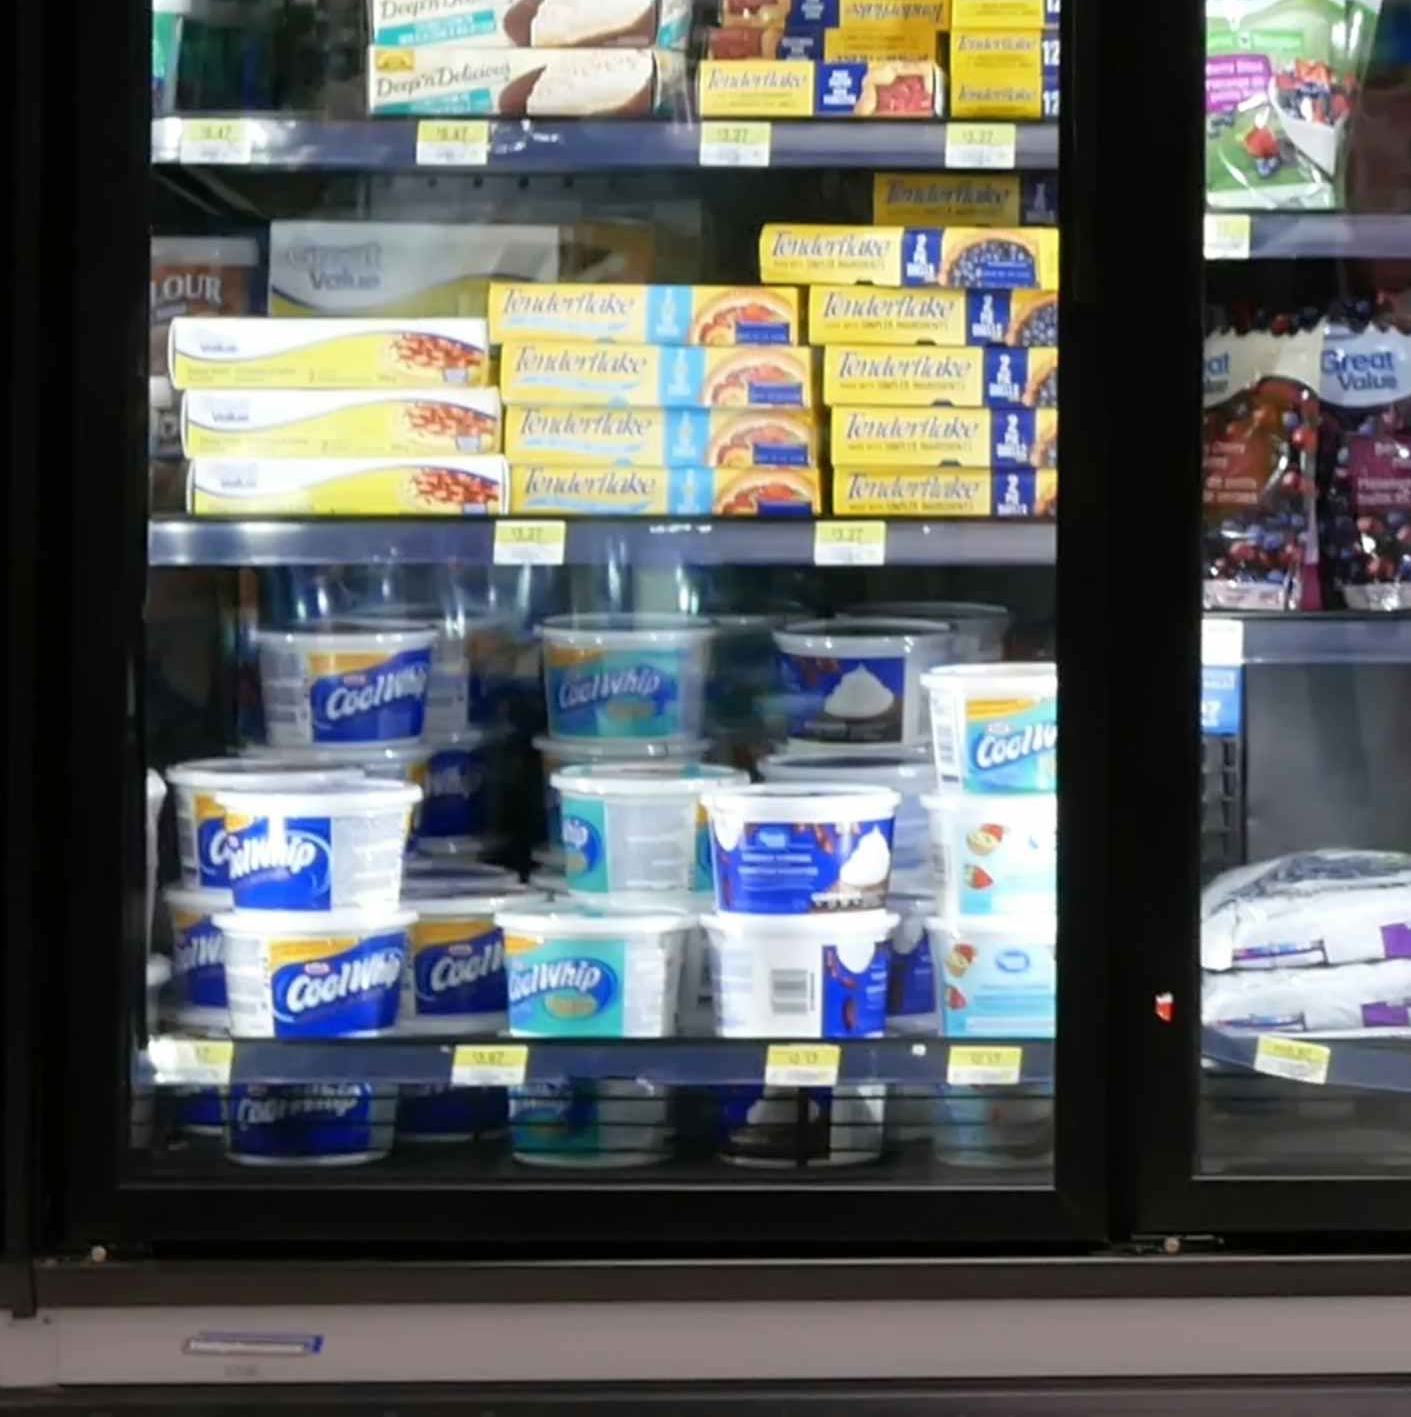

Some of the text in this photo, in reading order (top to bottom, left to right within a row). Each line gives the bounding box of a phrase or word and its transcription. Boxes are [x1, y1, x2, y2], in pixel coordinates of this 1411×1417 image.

[772, 233, 891, 258] Tenderflake
[504, 287, 634, 316] Tenderflake
[823, 293, 954, 318] Tenderflake
[515, 347, 646, 374] Tenderflake
[839, 352, 972, 378] Tenderflake
[1321, 350, 1394, 375] Great
[1337, 374, 1398, 393] Value
[520, 407, 652, 435] Tenderflake
[845, 411, 979, 439] Tenderflake
[524, 467, 655, 496] Tenderflake
[848, 471, 980, 499] Tenderflake
